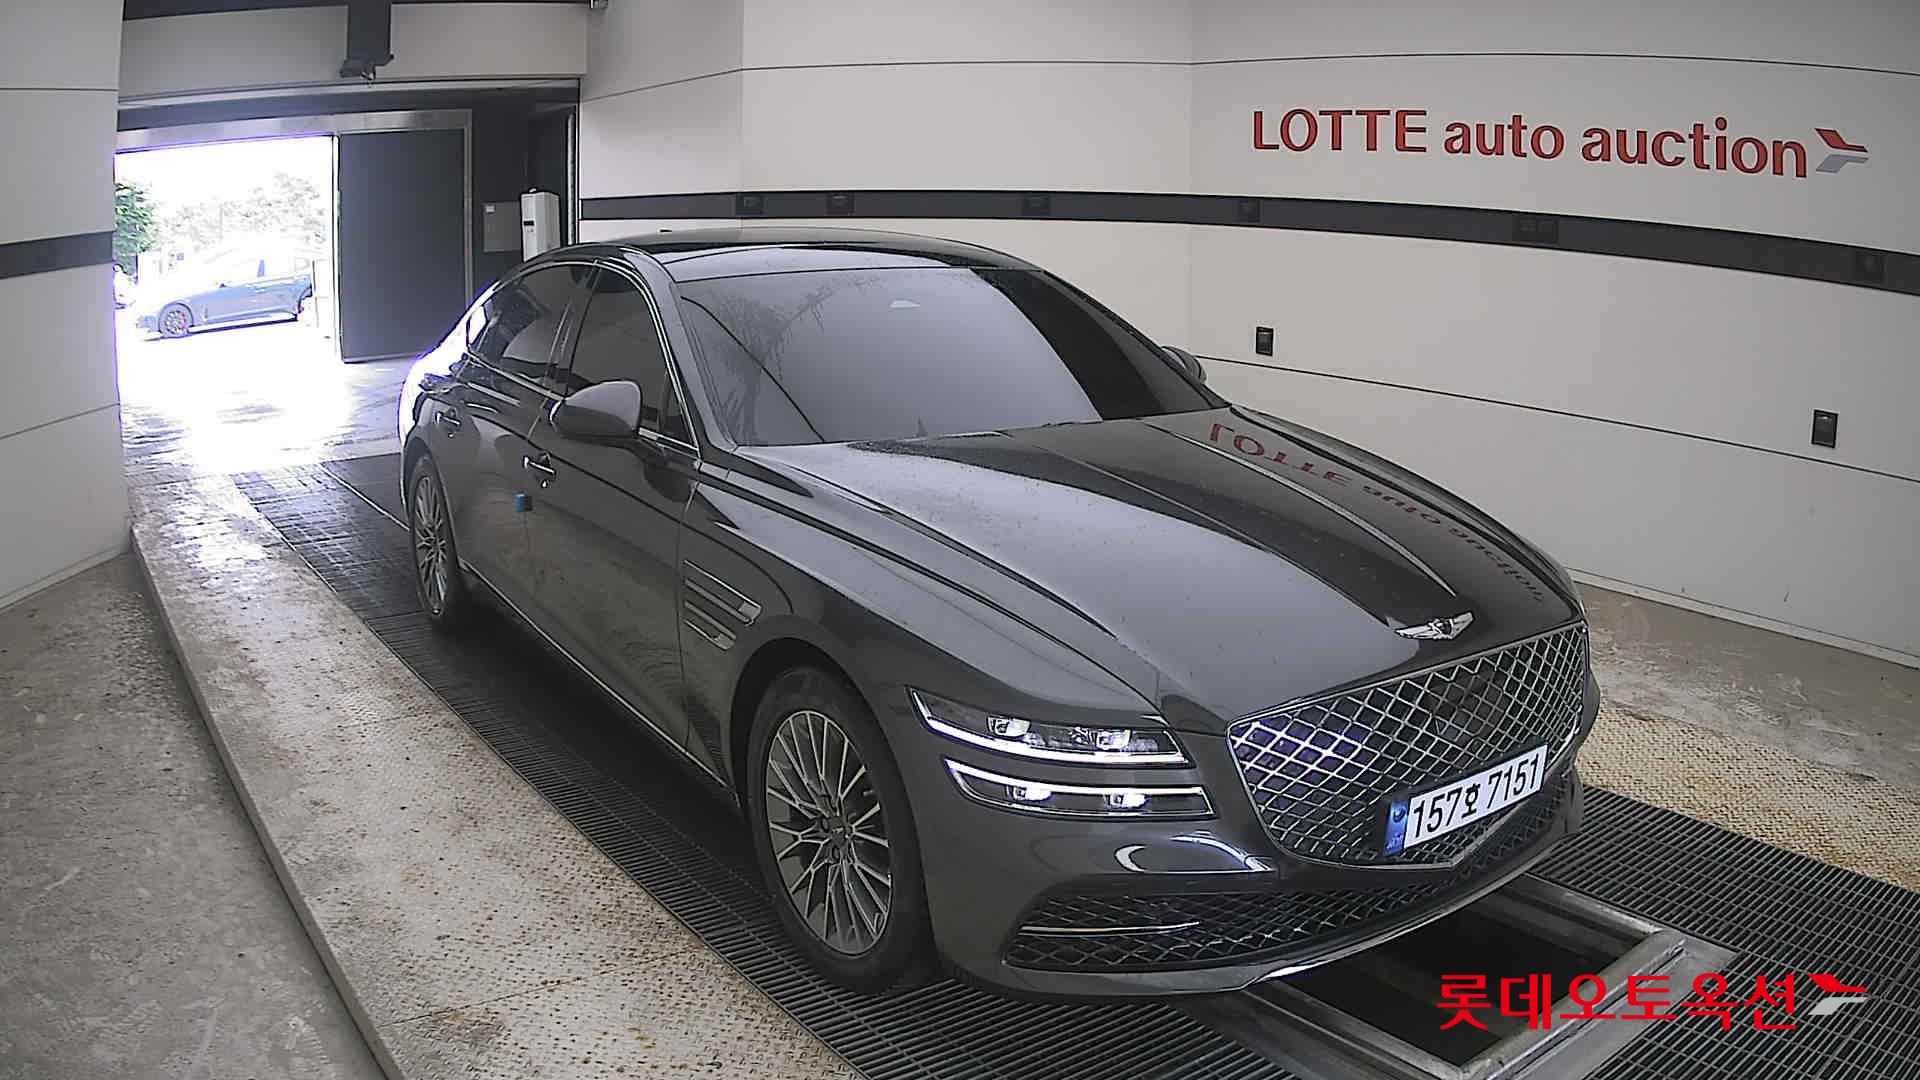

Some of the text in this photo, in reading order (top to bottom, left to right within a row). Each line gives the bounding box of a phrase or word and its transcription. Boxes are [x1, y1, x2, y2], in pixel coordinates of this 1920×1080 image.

[1252, 109, 1808, 179] LOTTE auto auction
[1413, 753, 1540, 838] 157호 7151
